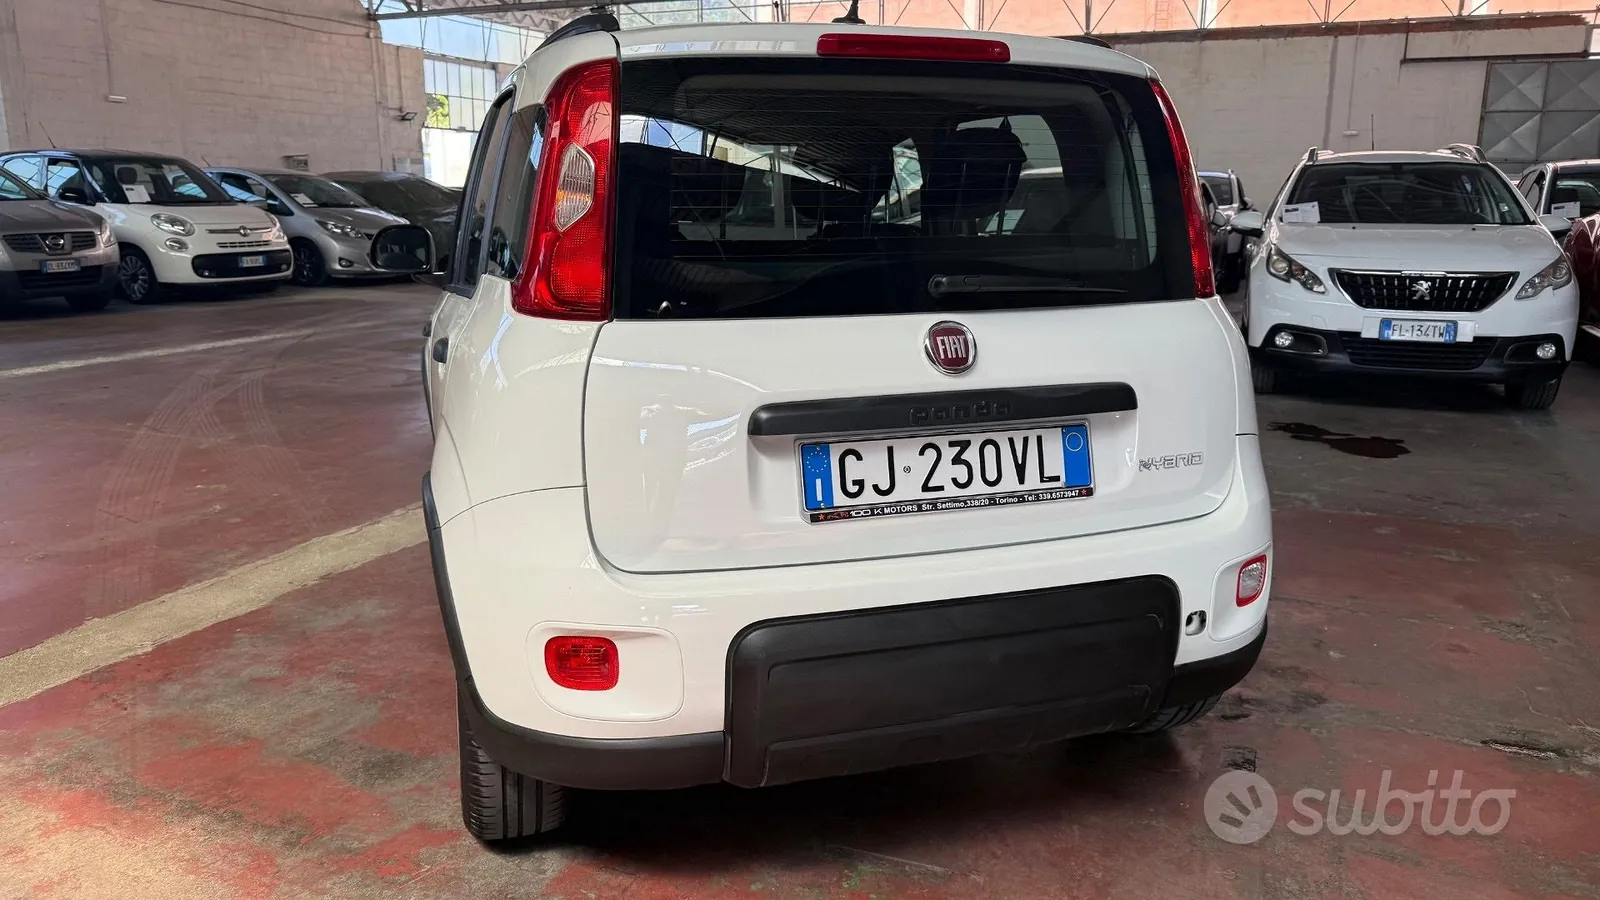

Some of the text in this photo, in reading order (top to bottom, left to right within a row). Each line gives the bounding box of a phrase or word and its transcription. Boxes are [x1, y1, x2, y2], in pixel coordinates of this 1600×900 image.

[936, 335, 967, 359] FIAT
[910, 401, 1012, 425] panda
[838, 434, 1061, 499] GJ 230VL
[850, 509, 871, 517] 100
[884, 505, 918, 514] MOTORS
[921, 502, 935, 511] Str.
[995, 496, 1018, 504] Torino
[1024, 494, 1037, 502] Tel:
